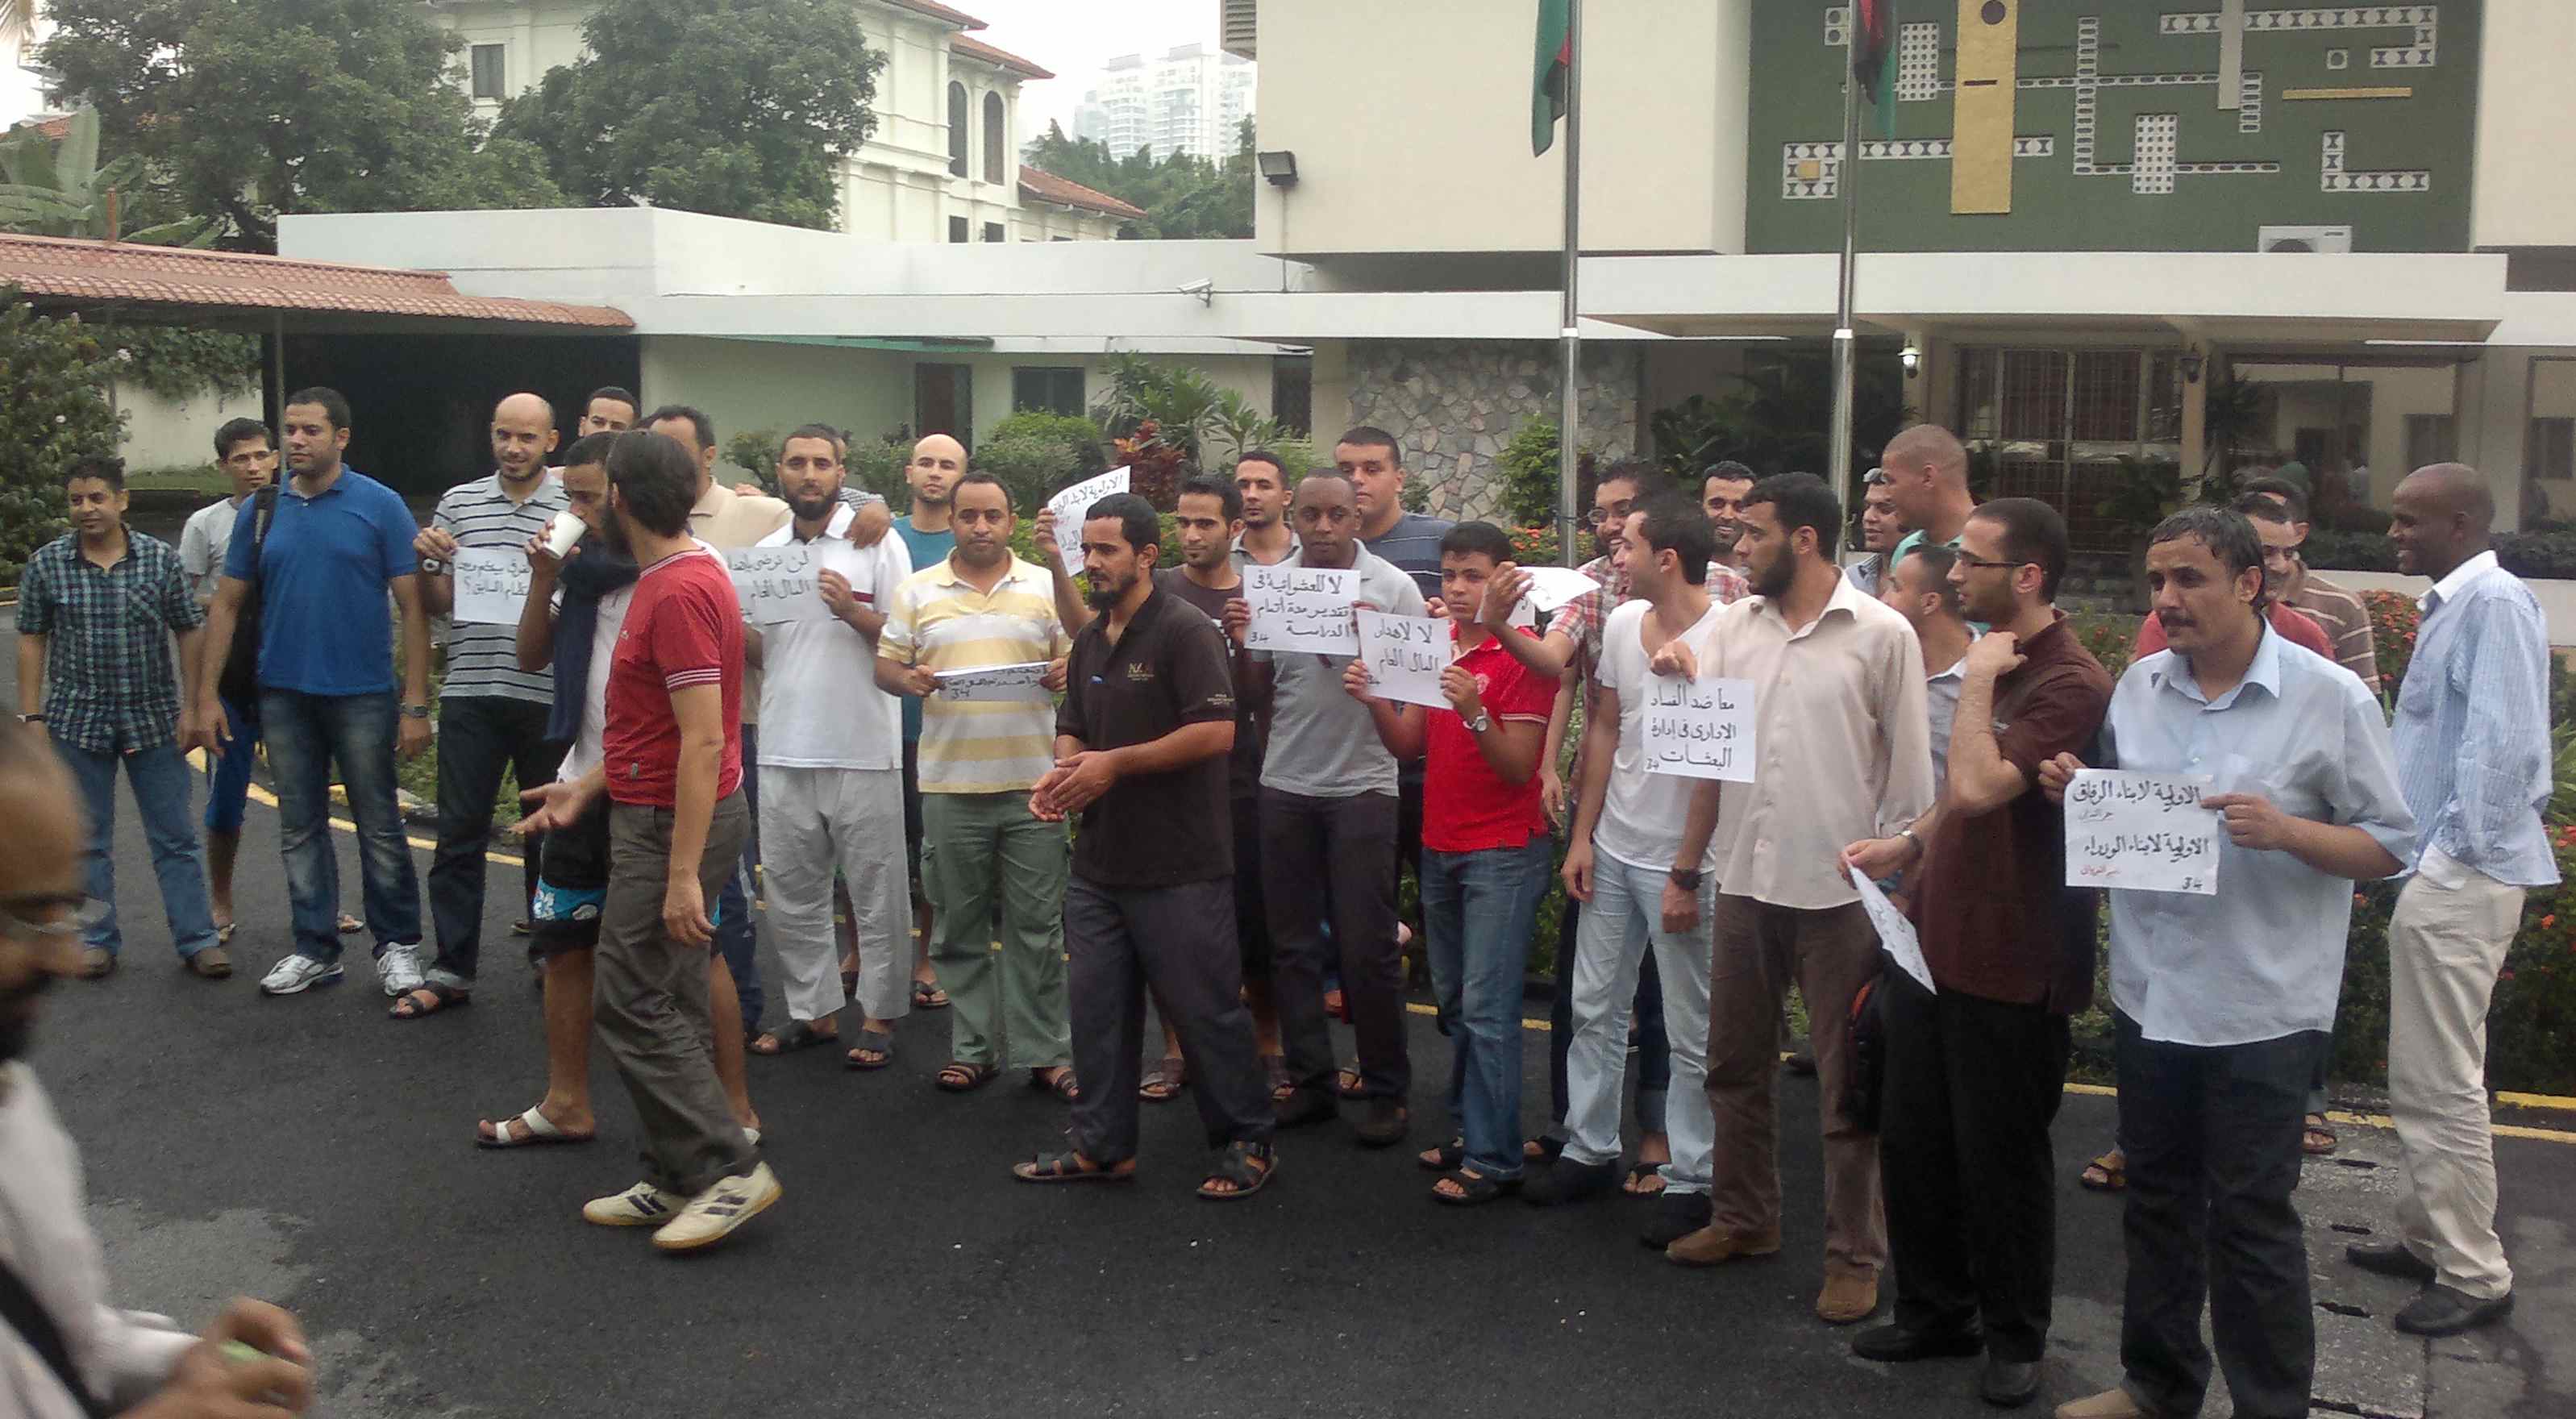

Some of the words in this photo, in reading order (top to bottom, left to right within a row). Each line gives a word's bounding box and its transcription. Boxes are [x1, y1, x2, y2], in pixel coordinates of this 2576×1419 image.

[1328, 575, 1342, 594] لا
[1286, 620, 1350, 638] الدراسة
[1417, 624, 1433, 643] لا
[1409, 652, 1438, 672] المال
[1691, 695, 1712, 710] ضد
[1658, 743, 1733, 771] البعثات
